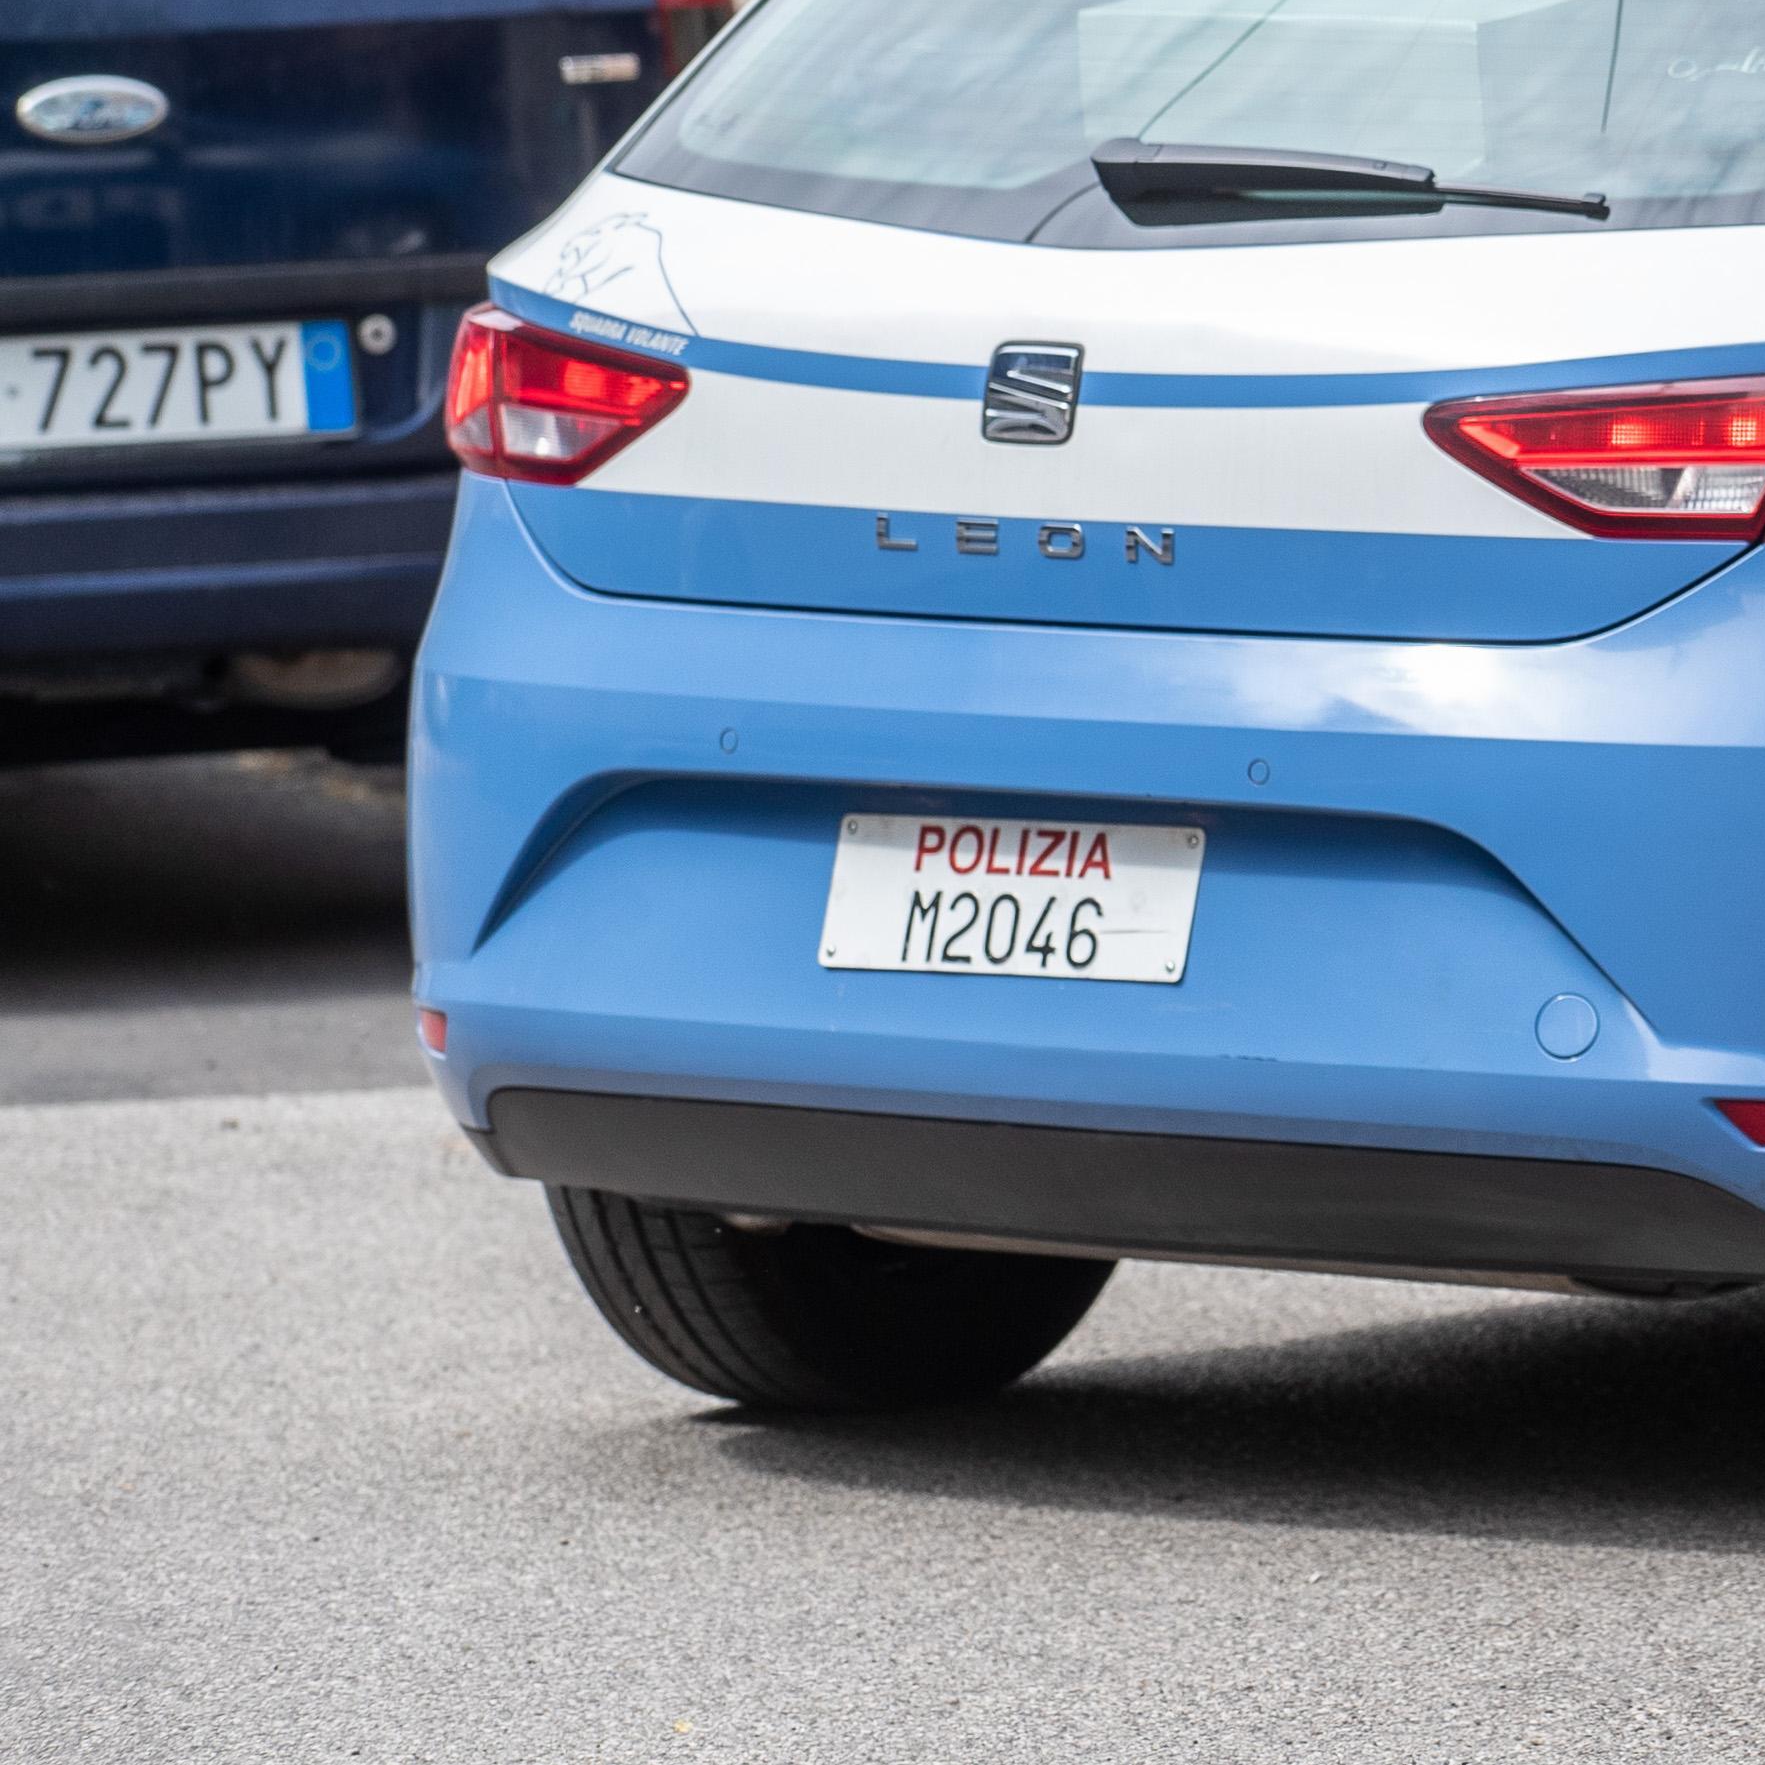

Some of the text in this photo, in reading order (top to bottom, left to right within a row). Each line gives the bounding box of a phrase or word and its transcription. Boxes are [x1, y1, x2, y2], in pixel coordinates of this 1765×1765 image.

[625, 325, 690, 357] VOLANTE
[32, 338, 288, 433] 727PY
[875, 512, 1178, 566] LEON
[914, 825, 1112, 881] POLIZIA
[902, 890, 1104, 971] M2046
